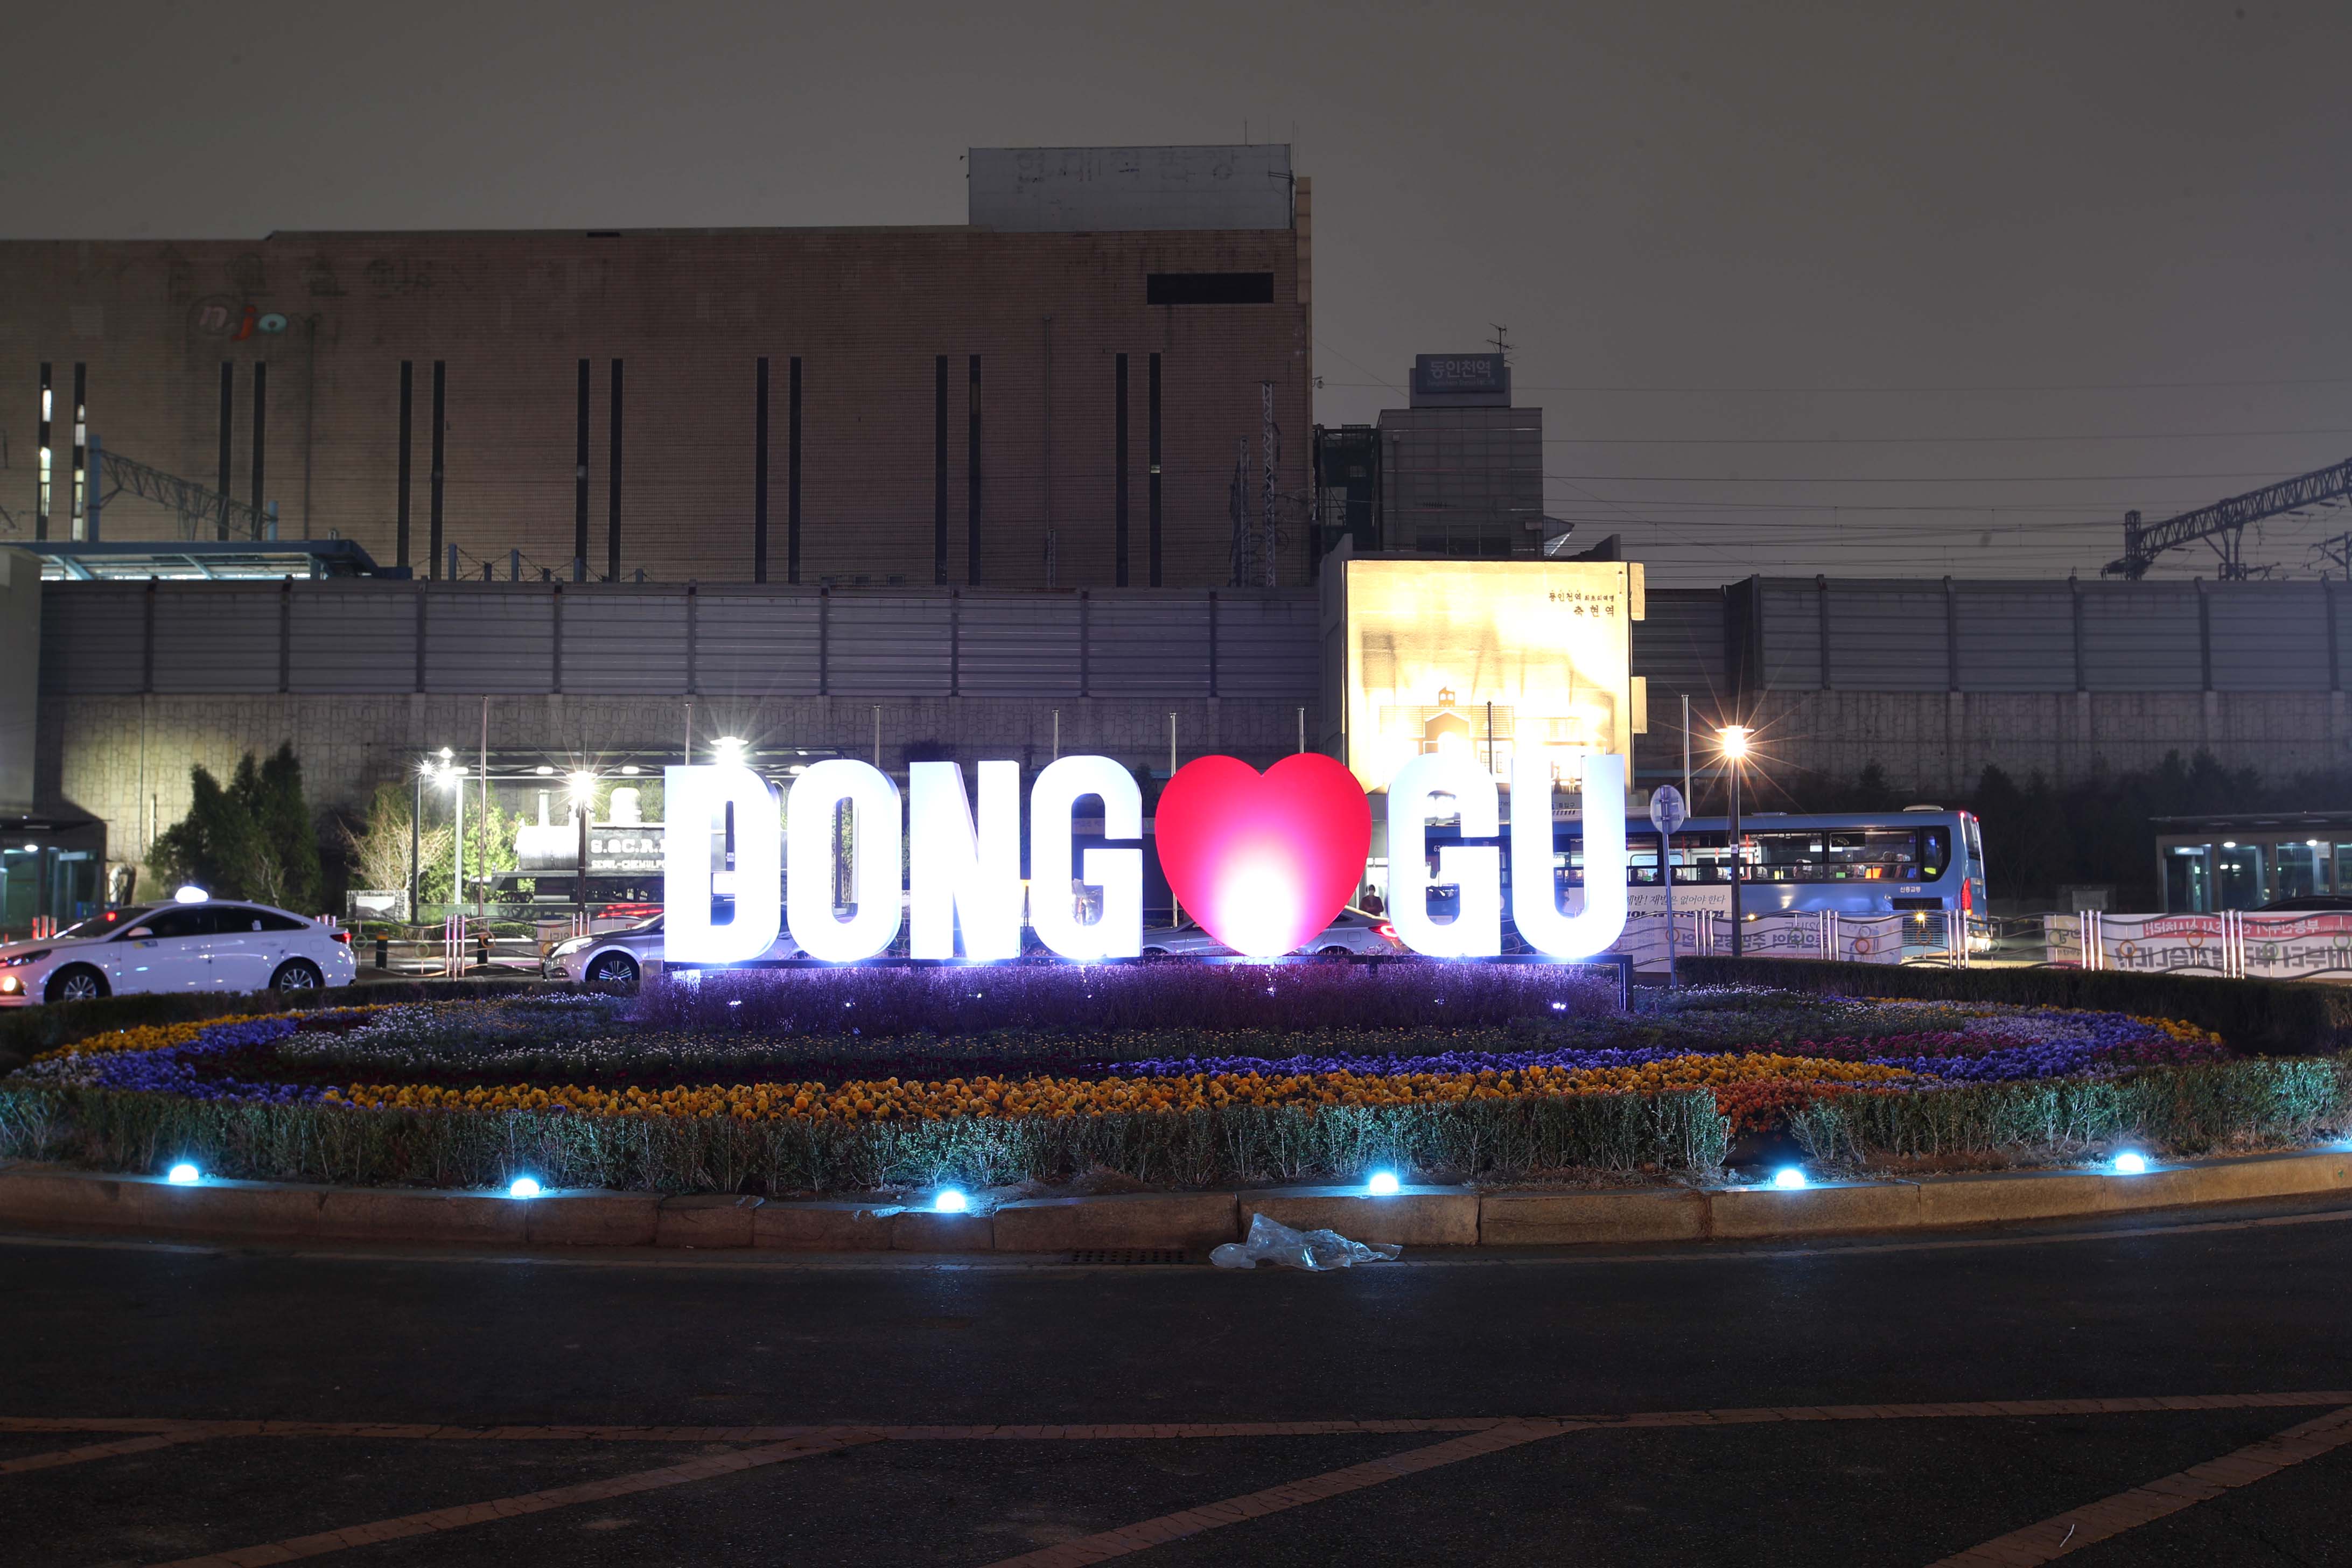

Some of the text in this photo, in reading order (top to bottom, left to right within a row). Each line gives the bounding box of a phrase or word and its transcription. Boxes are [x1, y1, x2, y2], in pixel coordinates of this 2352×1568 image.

[1430, 360, 1491, 379] 동인천역
[1549, 590, 1581, 602] 동인천역
[664, 755, 1143, 962] DONG
[1387, 753, 1628, 958] GU
[1681, 895, 1706, 905] 없어야
[1709, 895, 1726, 905] 한다
